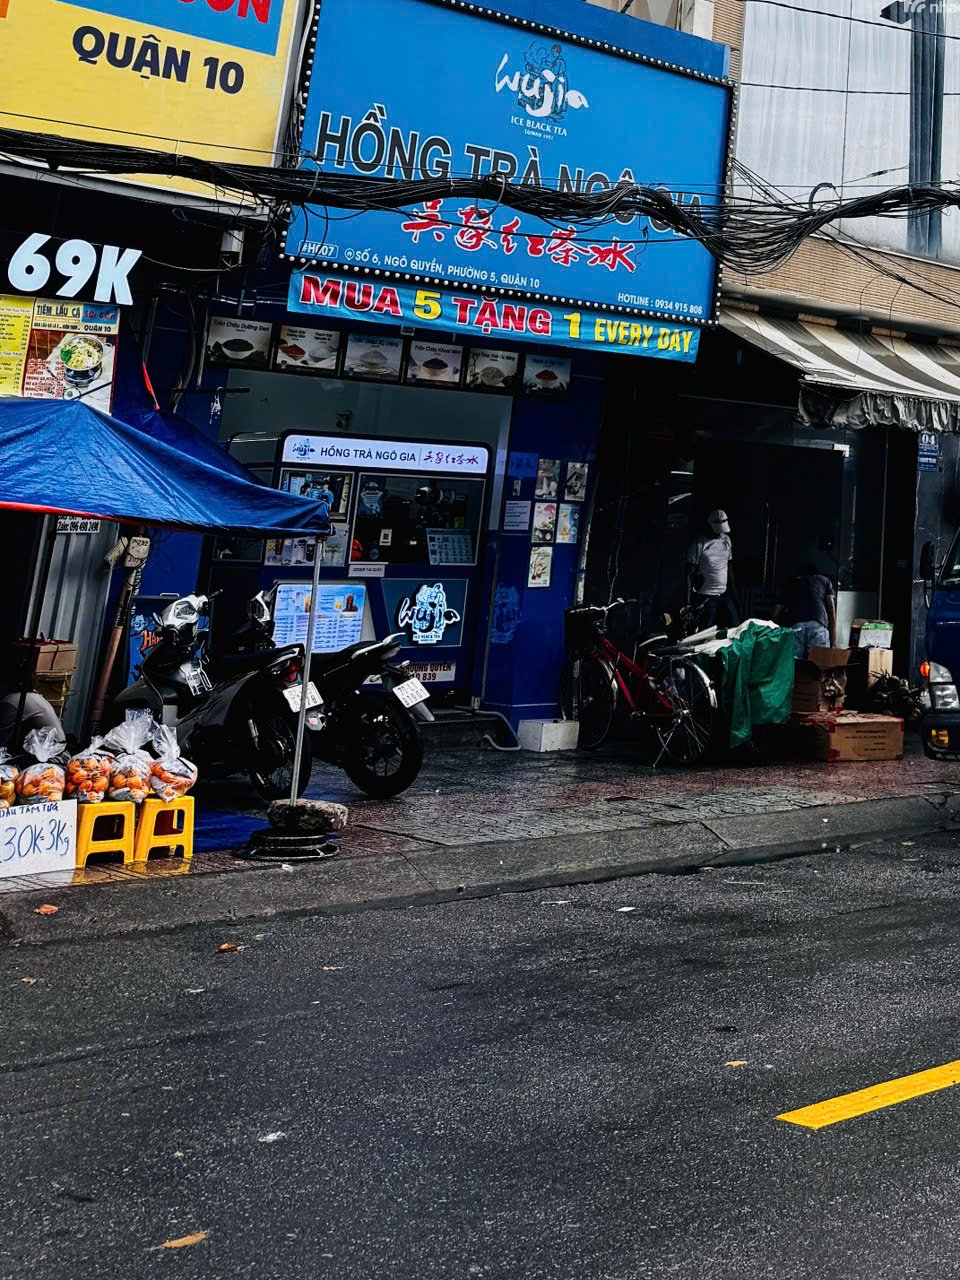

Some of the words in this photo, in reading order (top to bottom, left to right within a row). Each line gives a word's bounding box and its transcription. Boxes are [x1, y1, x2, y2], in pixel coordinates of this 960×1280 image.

[72, 25, 191, 81] QUẬN
[203, 56, 245, 95] 10
[314, 102, 452, 181] HỒNG
[464, 144, 543, 188] TRÀ
[510, 115, 524, 127] ICE
[526, 119, 552, 133] BLACK
[553, 125, 568, 137] TEA
[8, 232, 143, 306] 69K
[355, 247, 371, 262] SỐ
[371, 253, 381, 266] 6,
[384, 255, 408, 268] NGÔ
[447, 265, 488, 281] PHƯỜNG
[490, 272, 498, 284] 5,
[500, 273, 528, 289] QUẬN
[529, 278, 541, 289] 10
[299, 274, 404, 317] MUA
[412, 289, 442, 320] 5
[451, 295, 553, 336] TẶNG
[563, 311, 582, 339] 1
[594, 318, 654, 348] EVERY
[657, 327, 694, 353] DAY
[617, 292, 650, 307] HOTLINE
[654, 298, 674, 311] 0934
[674, 301, 688, 313] 915
[353, 447, 374, 460] TRÀ
[375, 449, 398, 462] NGÔ
[399, 451, 417, 463] GIA
[422, 672, 437, 681] 839
